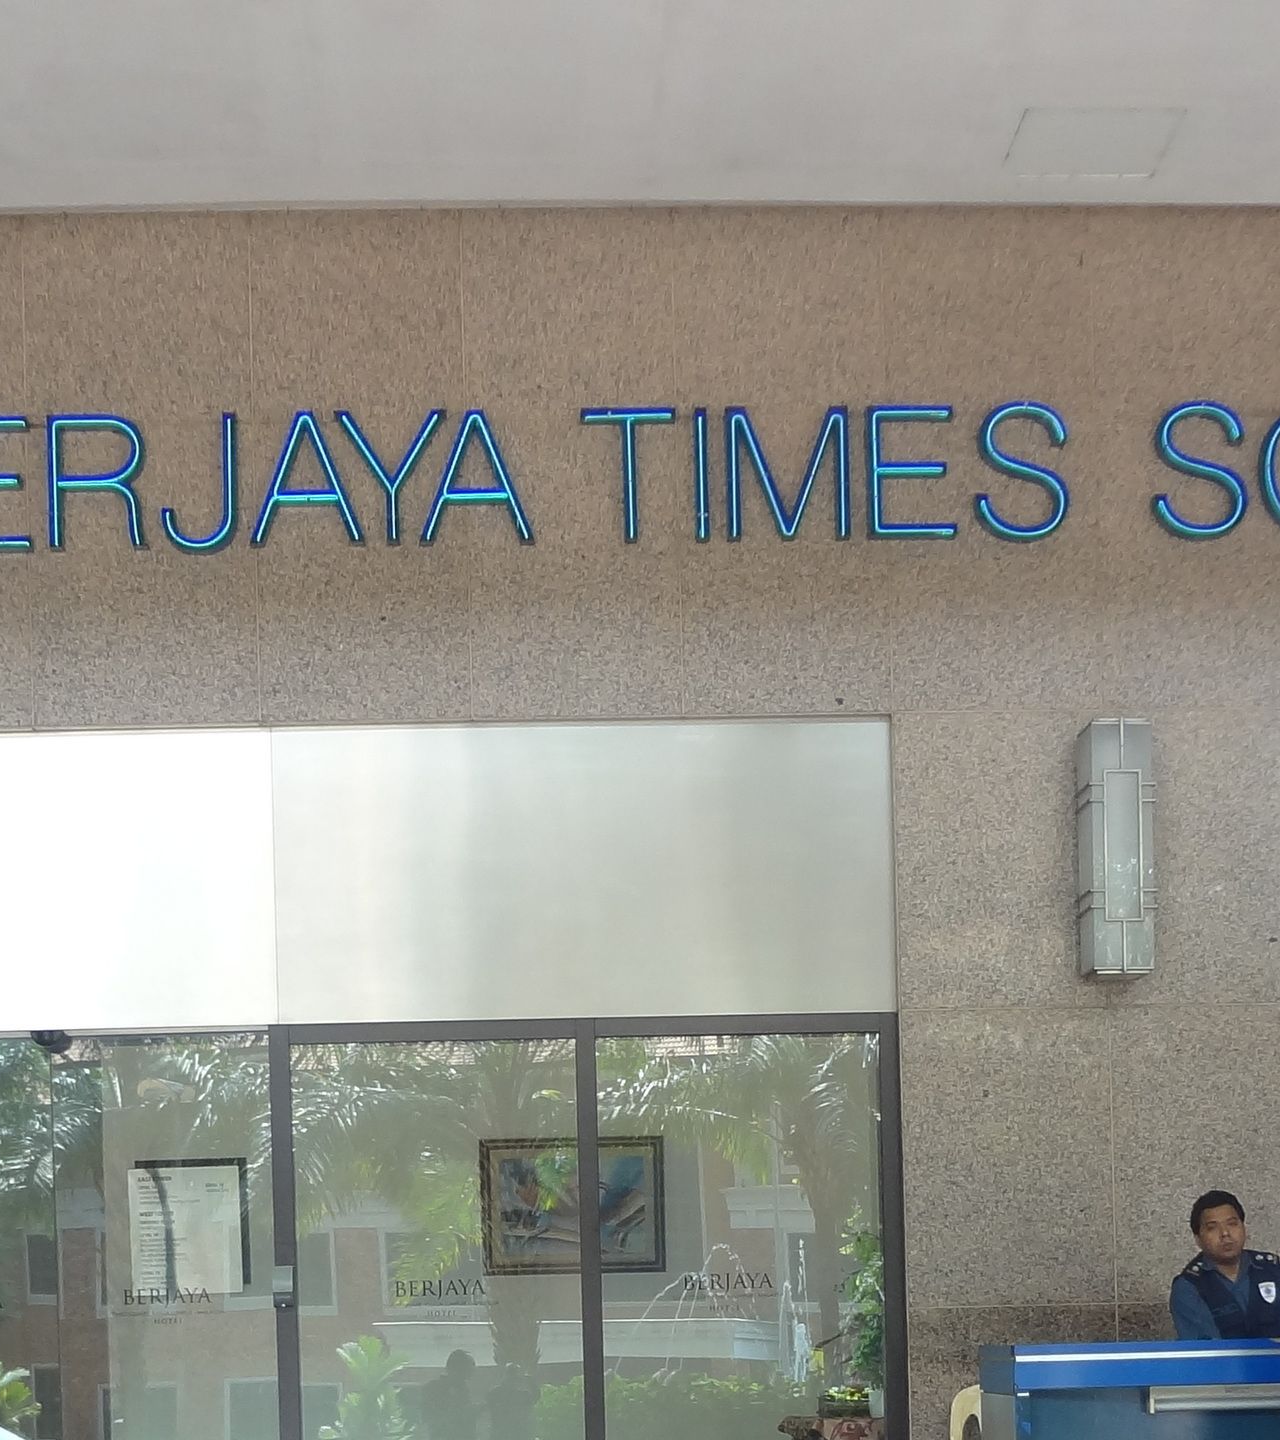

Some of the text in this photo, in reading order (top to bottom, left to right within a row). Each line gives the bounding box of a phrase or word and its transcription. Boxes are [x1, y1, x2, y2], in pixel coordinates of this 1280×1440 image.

[581, 402, 1068, 546] TIMES
[396, 1279, 486, 1299] BERJAYA
[683, 1273, 773, 1293] BERJAYA
[124, 1288, 213, 1308] BERJAYA
